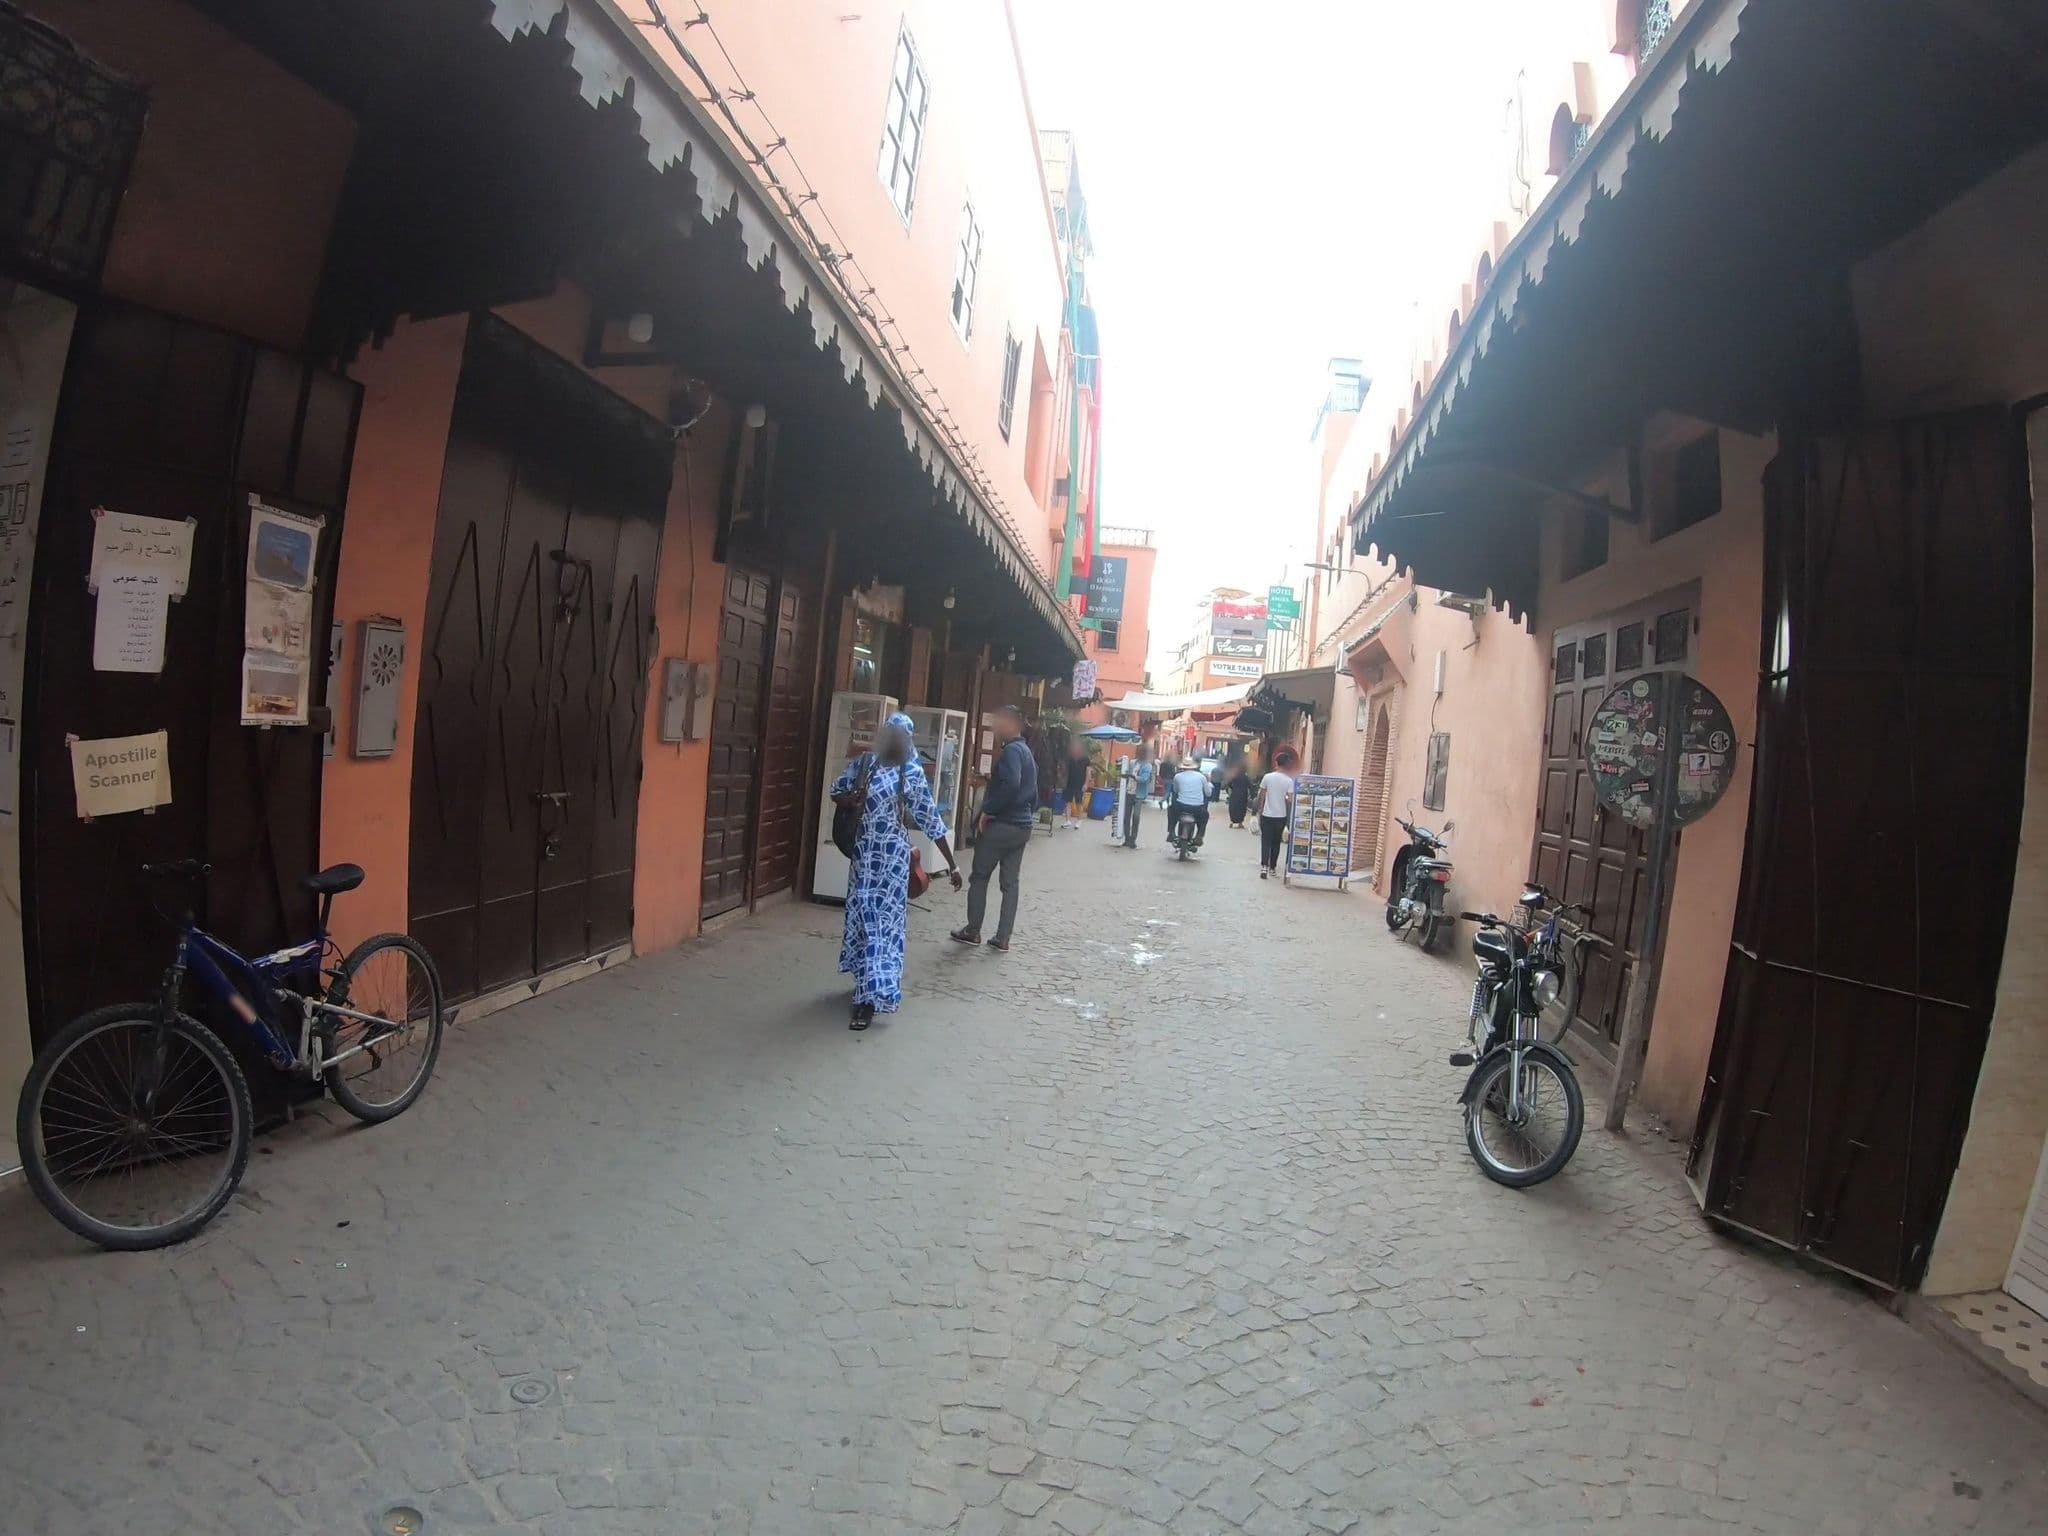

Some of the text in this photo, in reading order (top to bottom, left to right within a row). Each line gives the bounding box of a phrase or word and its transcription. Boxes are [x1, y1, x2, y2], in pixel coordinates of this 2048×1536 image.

[1212, 663, 1236, 671] VOTRE
[85, 746, 157, 768] Apostille
[89, 769, 156, 788] Scanner
